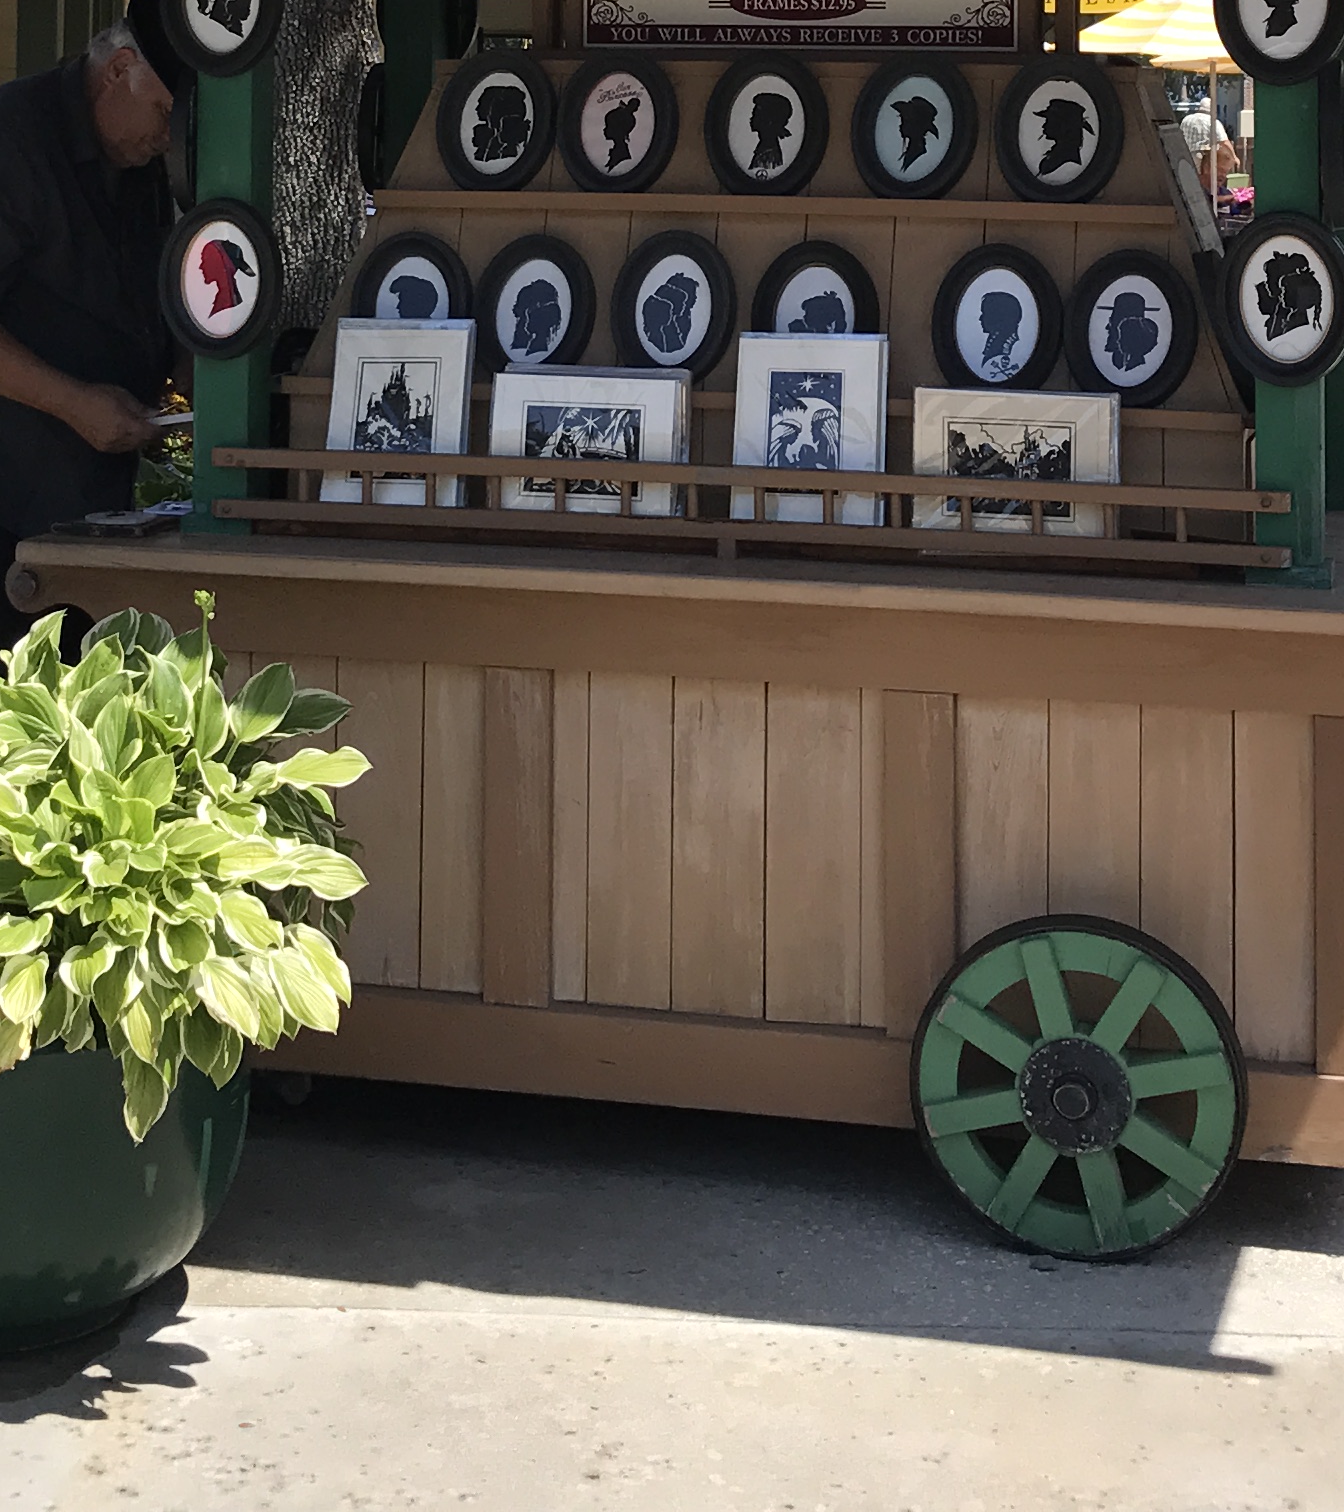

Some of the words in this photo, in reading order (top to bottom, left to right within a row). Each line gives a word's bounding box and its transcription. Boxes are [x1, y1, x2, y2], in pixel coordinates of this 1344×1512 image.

[610, 27, 650, 43] YOU
[657, 27, 707, 43] WILL
[713, 27, 792, 44] ALWAYS
[798, 28, 882, 44] RECEIVE
[889, 28, 899, 44] 3
[906, 28, 983, 45] COPIES!
